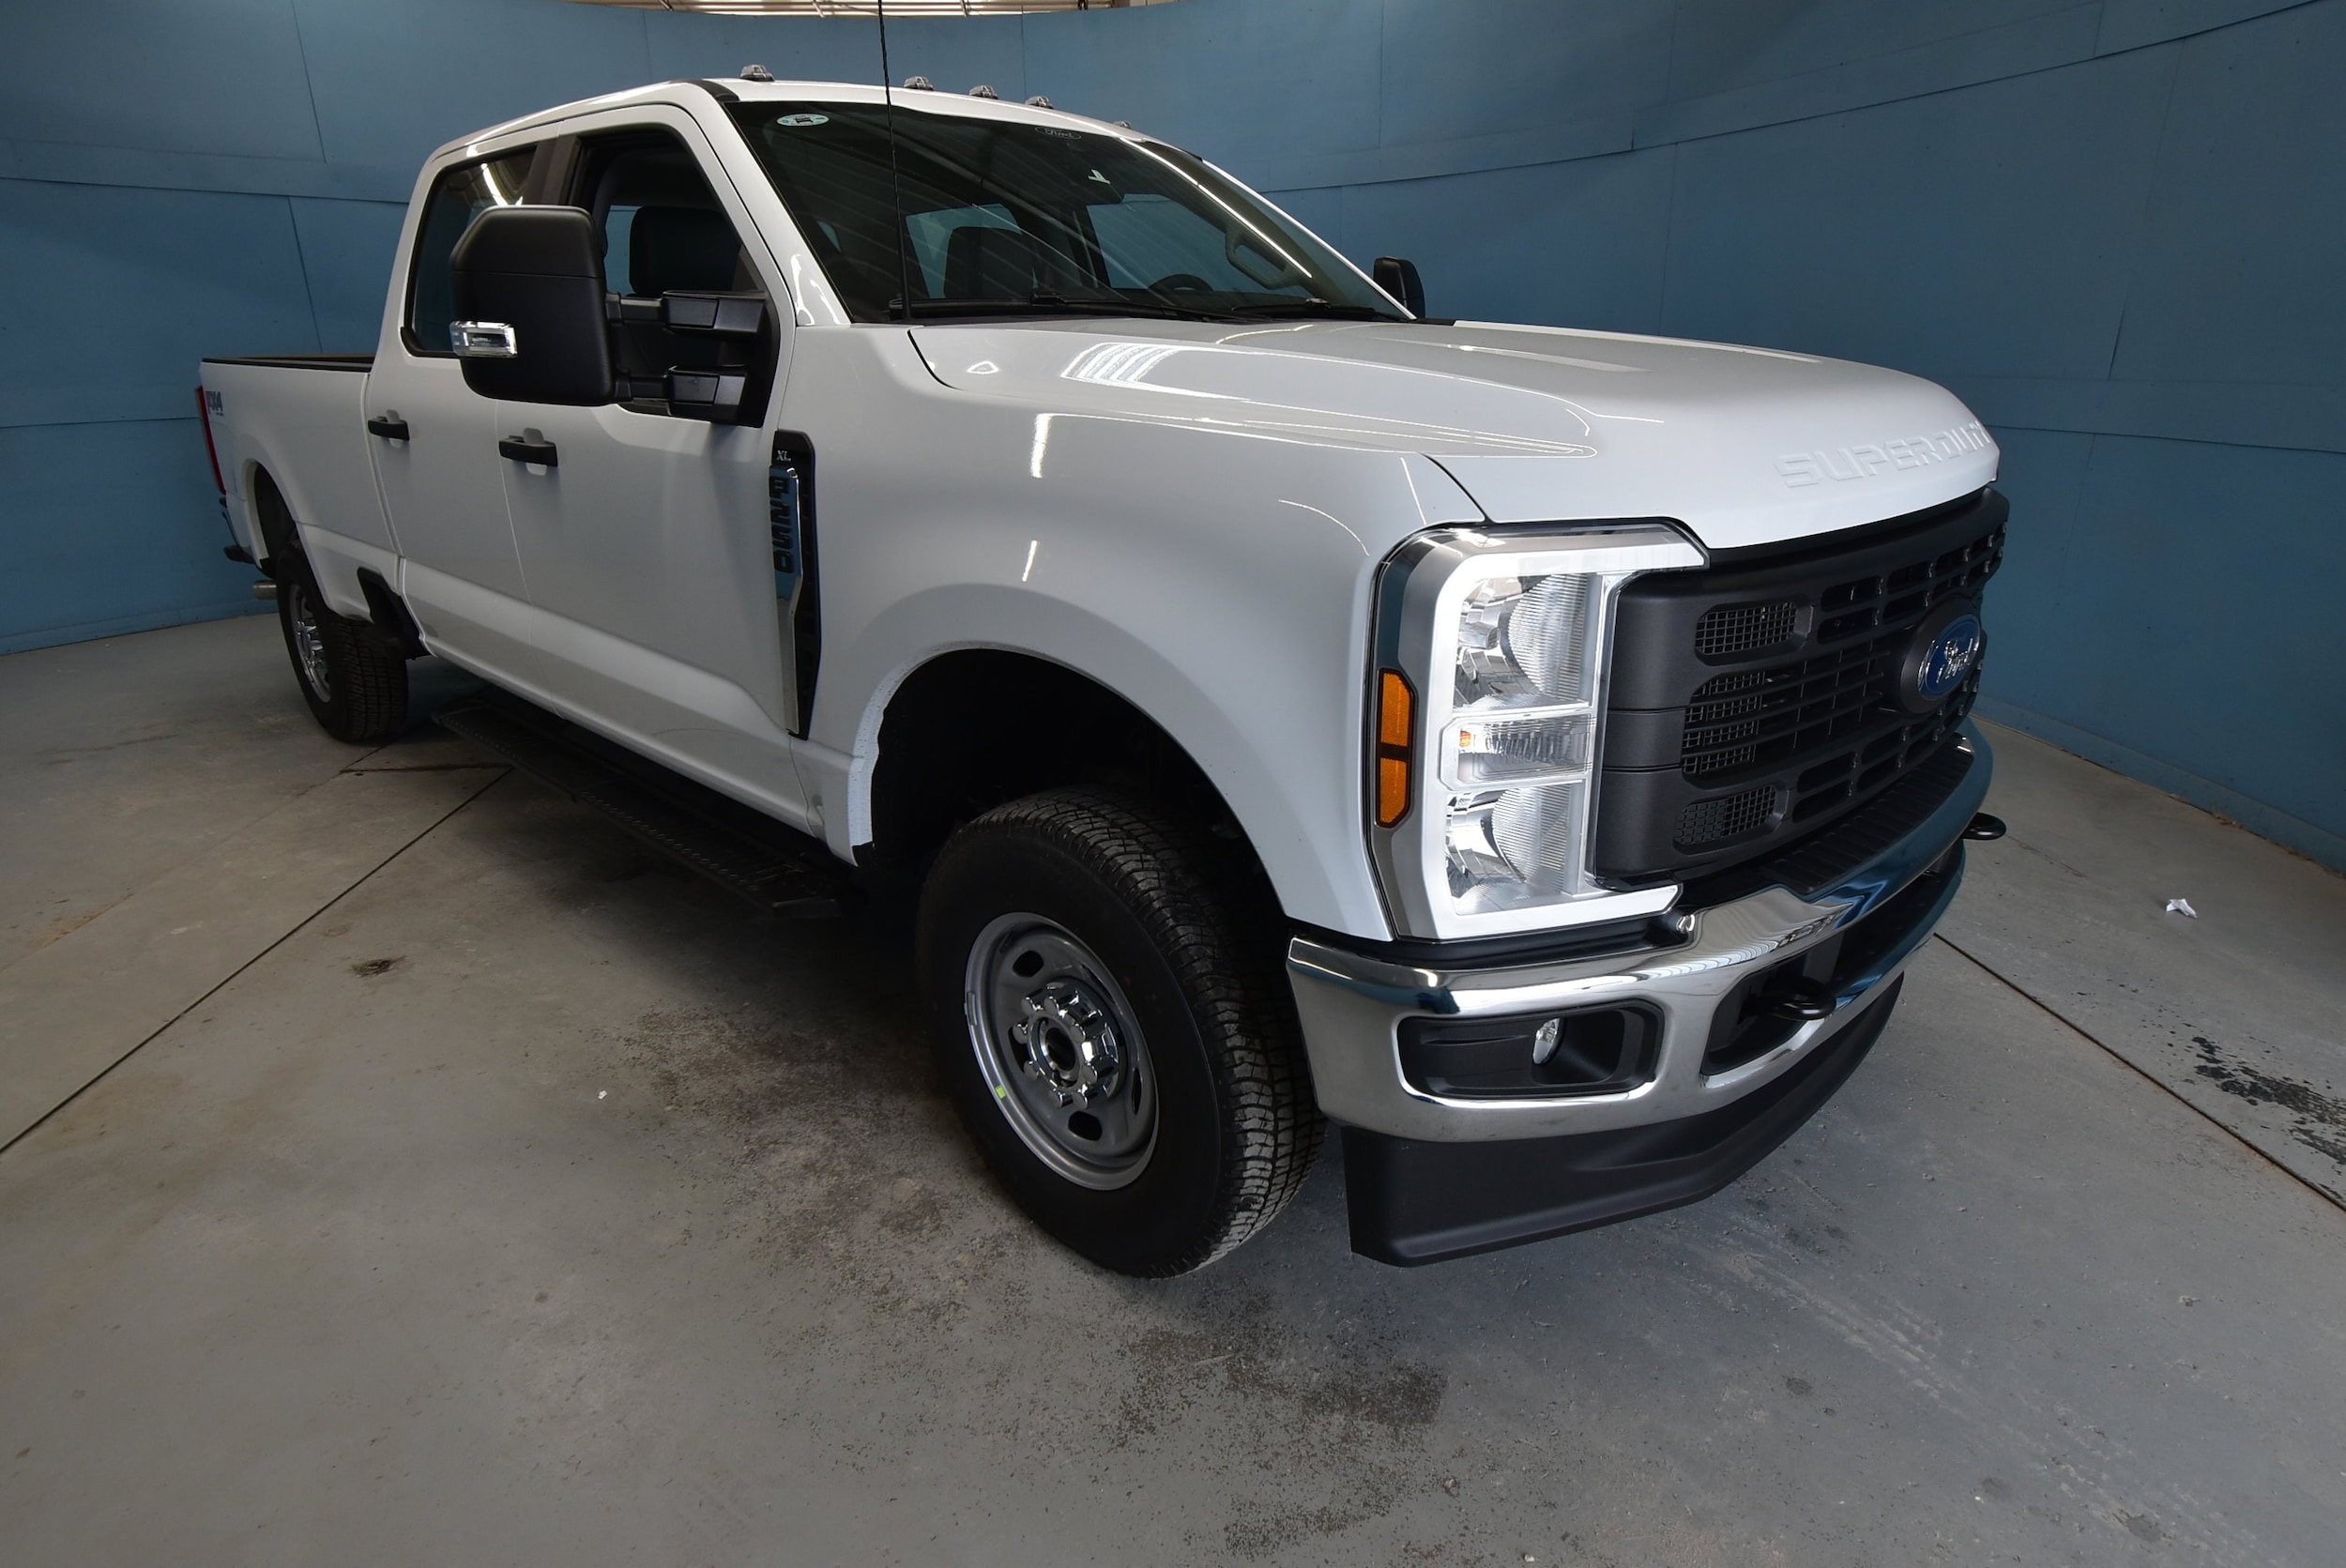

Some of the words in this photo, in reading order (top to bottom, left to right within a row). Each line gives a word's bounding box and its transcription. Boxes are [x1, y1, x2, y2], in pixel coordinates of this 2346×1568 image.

[776, 449, 792, 462] XL
[769, 476, 795, 574] F250
[1935, 635, 1974, 684] Ford
